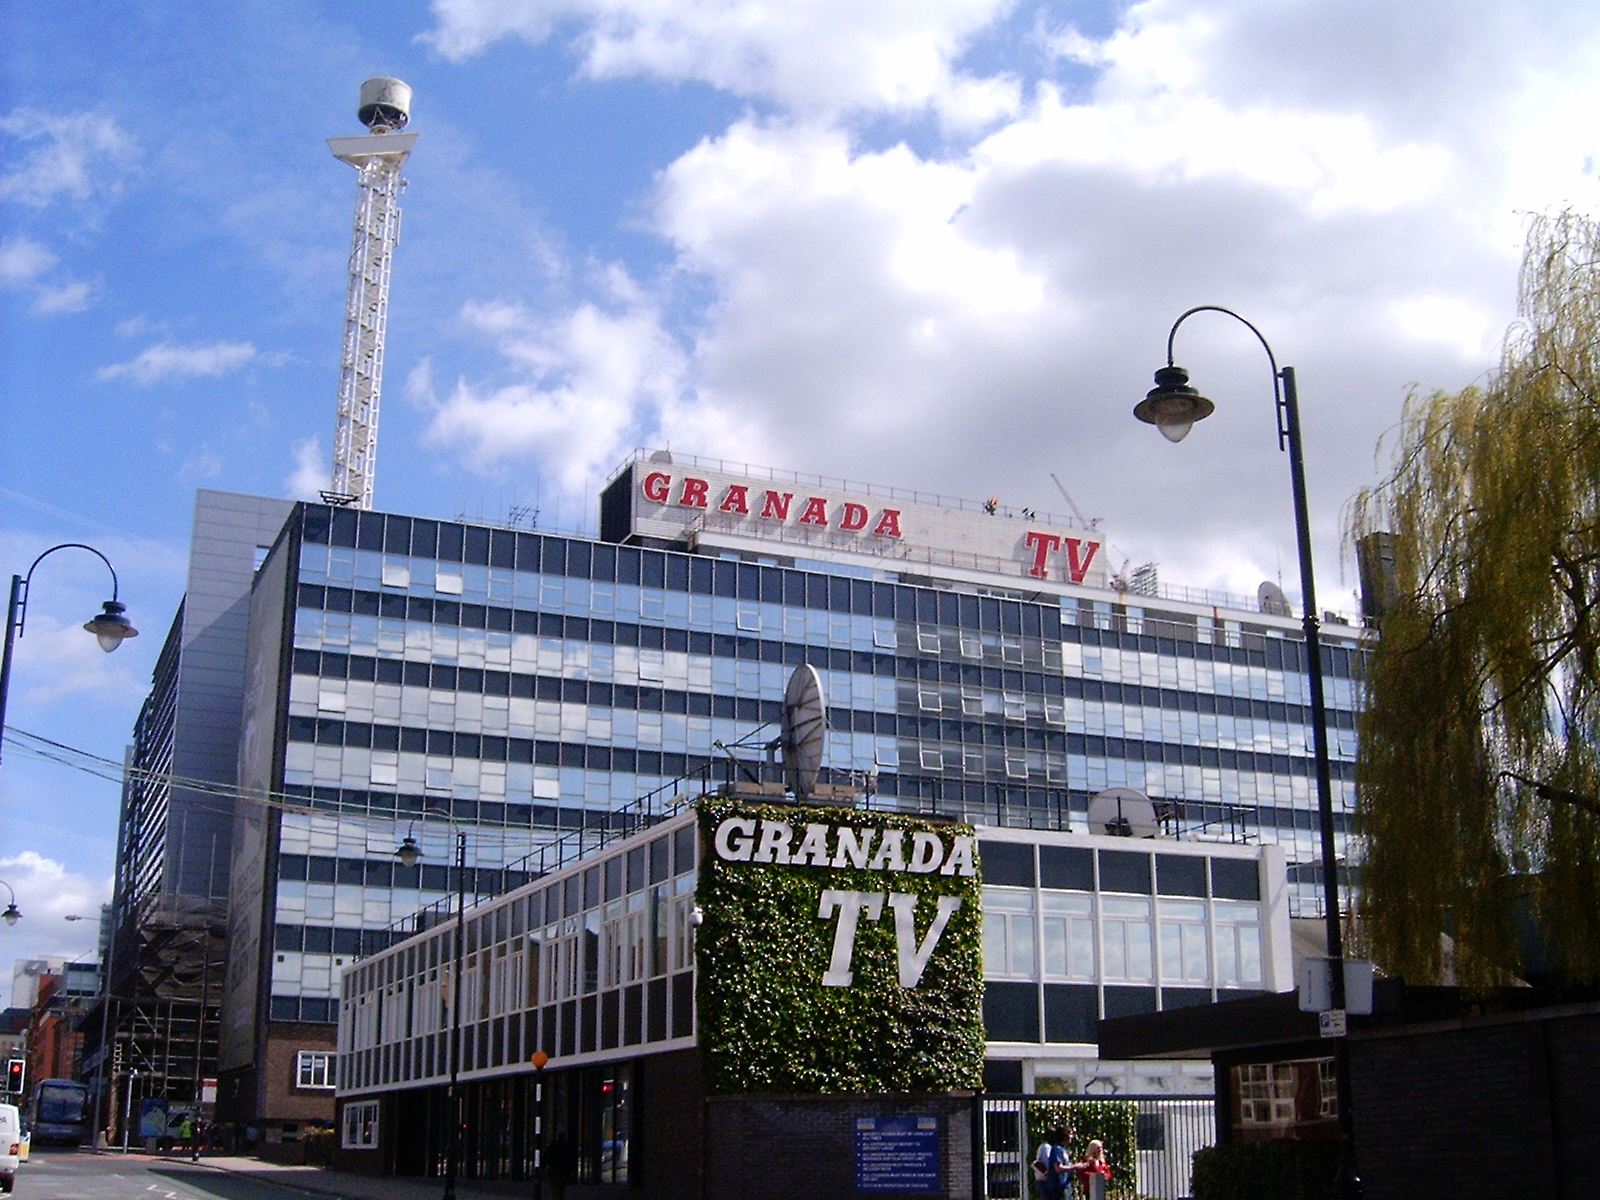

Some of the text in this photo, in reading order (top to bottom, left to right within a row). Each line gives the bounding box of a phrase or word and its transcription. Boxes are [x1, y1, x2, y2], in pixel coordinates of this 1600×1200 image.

[643, 472, 1100, 583] GRANADA TV
[715, 817, 977, 877] GRANADA
[817, 889, 962, 988] TV
